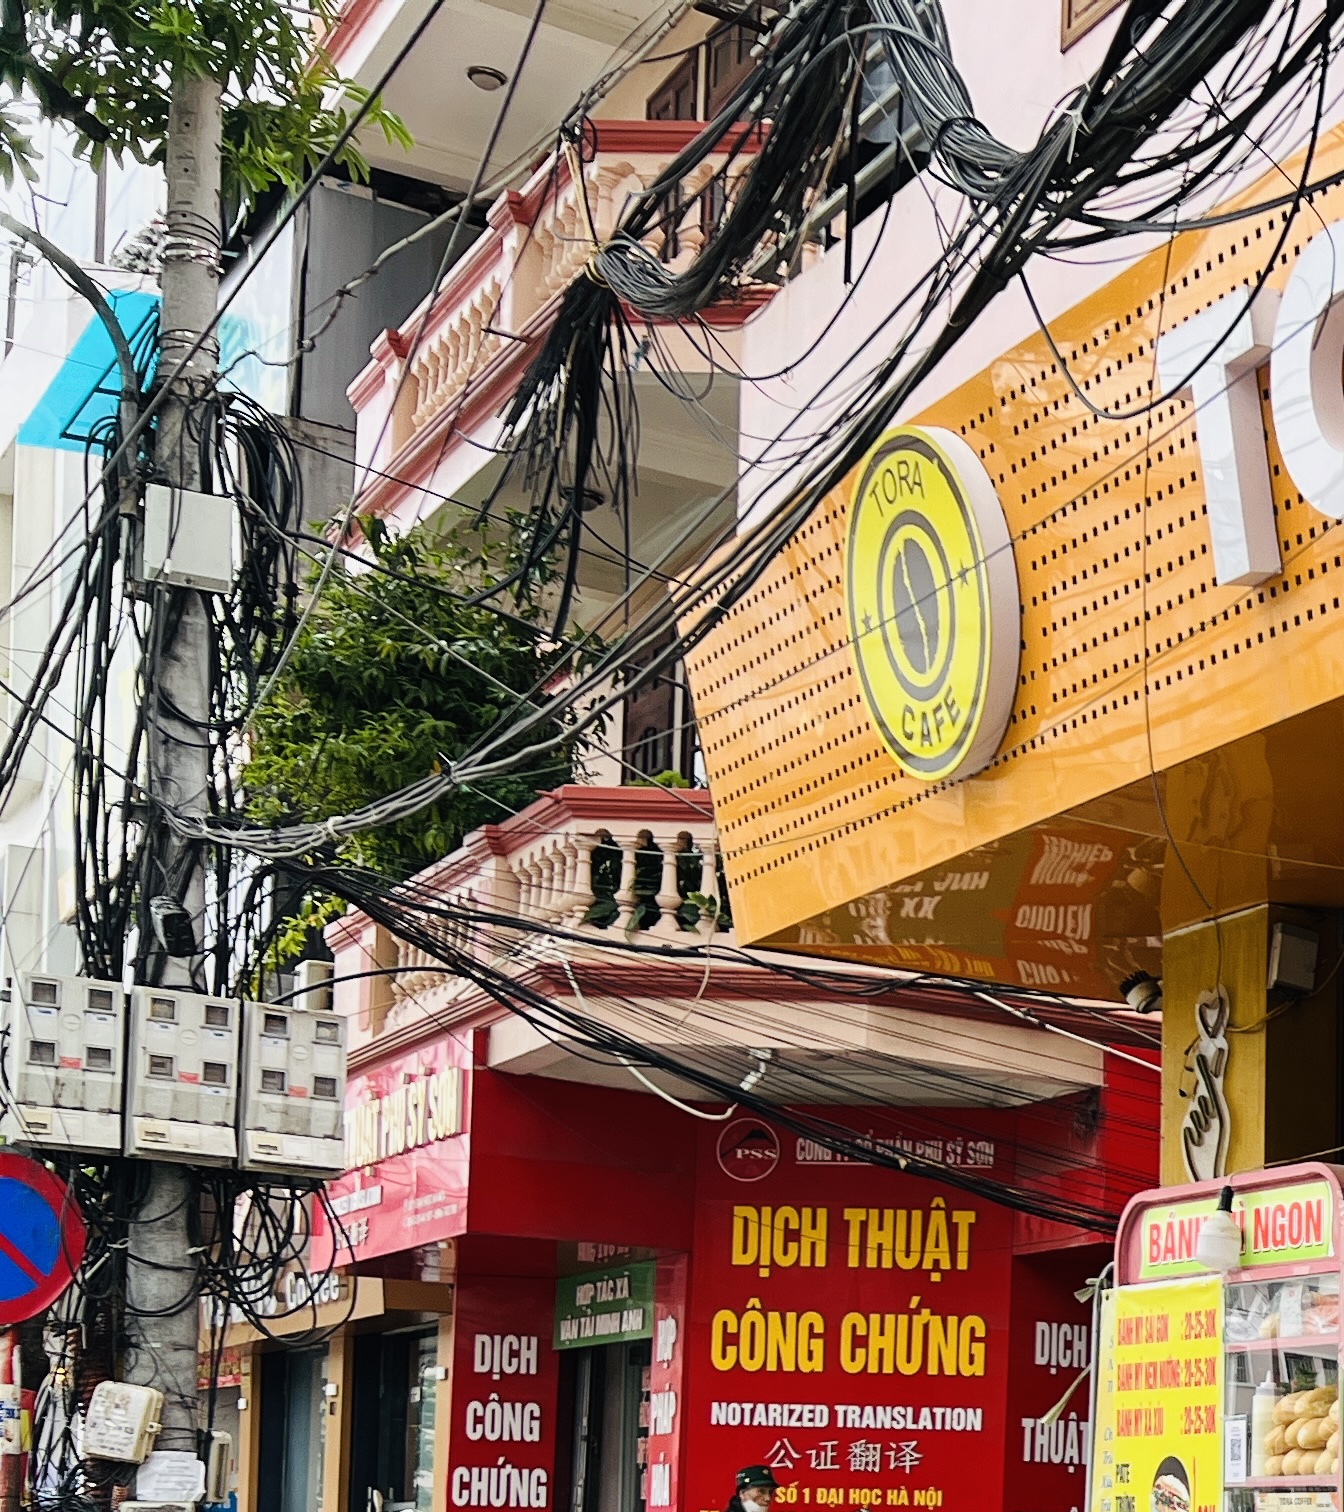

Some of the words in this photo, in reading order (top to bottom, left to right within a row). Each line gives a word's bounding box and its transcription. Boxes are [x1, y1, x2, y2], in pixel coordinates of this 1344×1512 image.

[869, 459, 926, 518] TORA
[901, 684, 963, 748] CAFE
[735, 1148, 777, 1160] PSS
[732, 1205, 828, 1278] DỊCH
[843, 1197, 976, 1282] THUẬT
[1254, 1198, 1324, 1251] NGON
[596, 1275, 615, 1303] TÁC
[474, 1334, 538, 1376] DỊCH
[711, 1297, 825, 1373] CÔNG
[840, 1295, 986, 1376] CHỨNG
[1034, 1321, 1088, 1375] DỊCH
[466, 1394, 540, 1443] CÔNG
[711, 1402, 829, 1428] NOTARIZED
[834, 1404, 983, 1431] TRANSLATION
[764, 1437, 924, 1474] 公证翻译
[452, 1457, 547, 1509] CHỨNG
[775, 1481, 798, 1505] SỐ
[802, 1489, 811, 1505] 1
[816, 1488, 844, 1510] ĐẠI
[849, 1488, 881, 1511] HỌC
[887, 1483, 908, 1506] HÀ
[913, 1485, 943, 1509] NỘI
